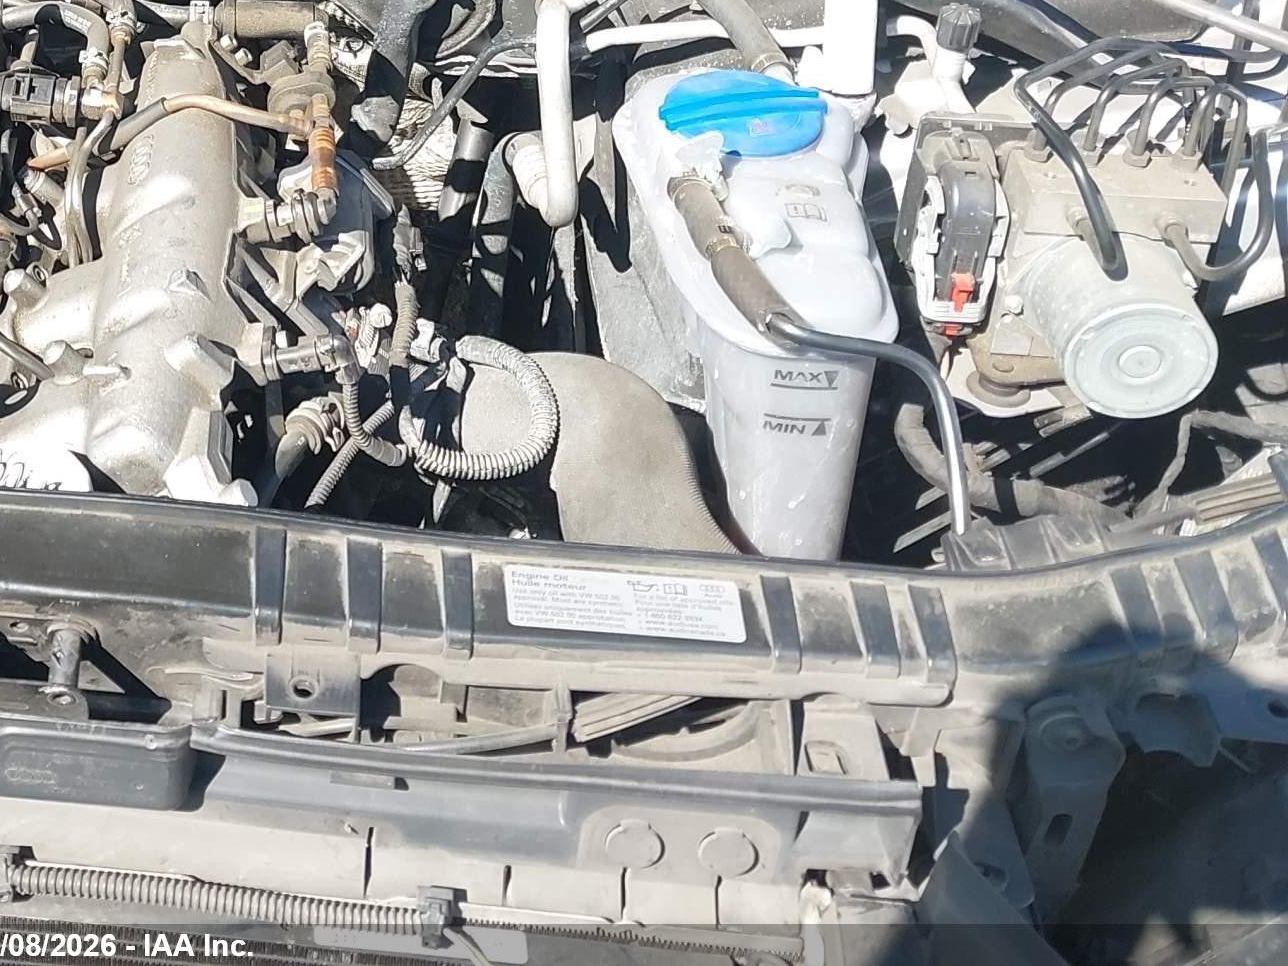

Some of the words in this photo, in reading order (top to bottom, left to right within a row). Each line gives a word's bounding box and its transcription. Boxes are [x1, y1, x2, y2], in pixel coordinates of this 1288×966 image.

[774, 369, 823, 383] MAX
[763, 420, 806, 435] MIN
[511, 571, 549, 579] Engine
[543, 581, 586, 589] moteur
